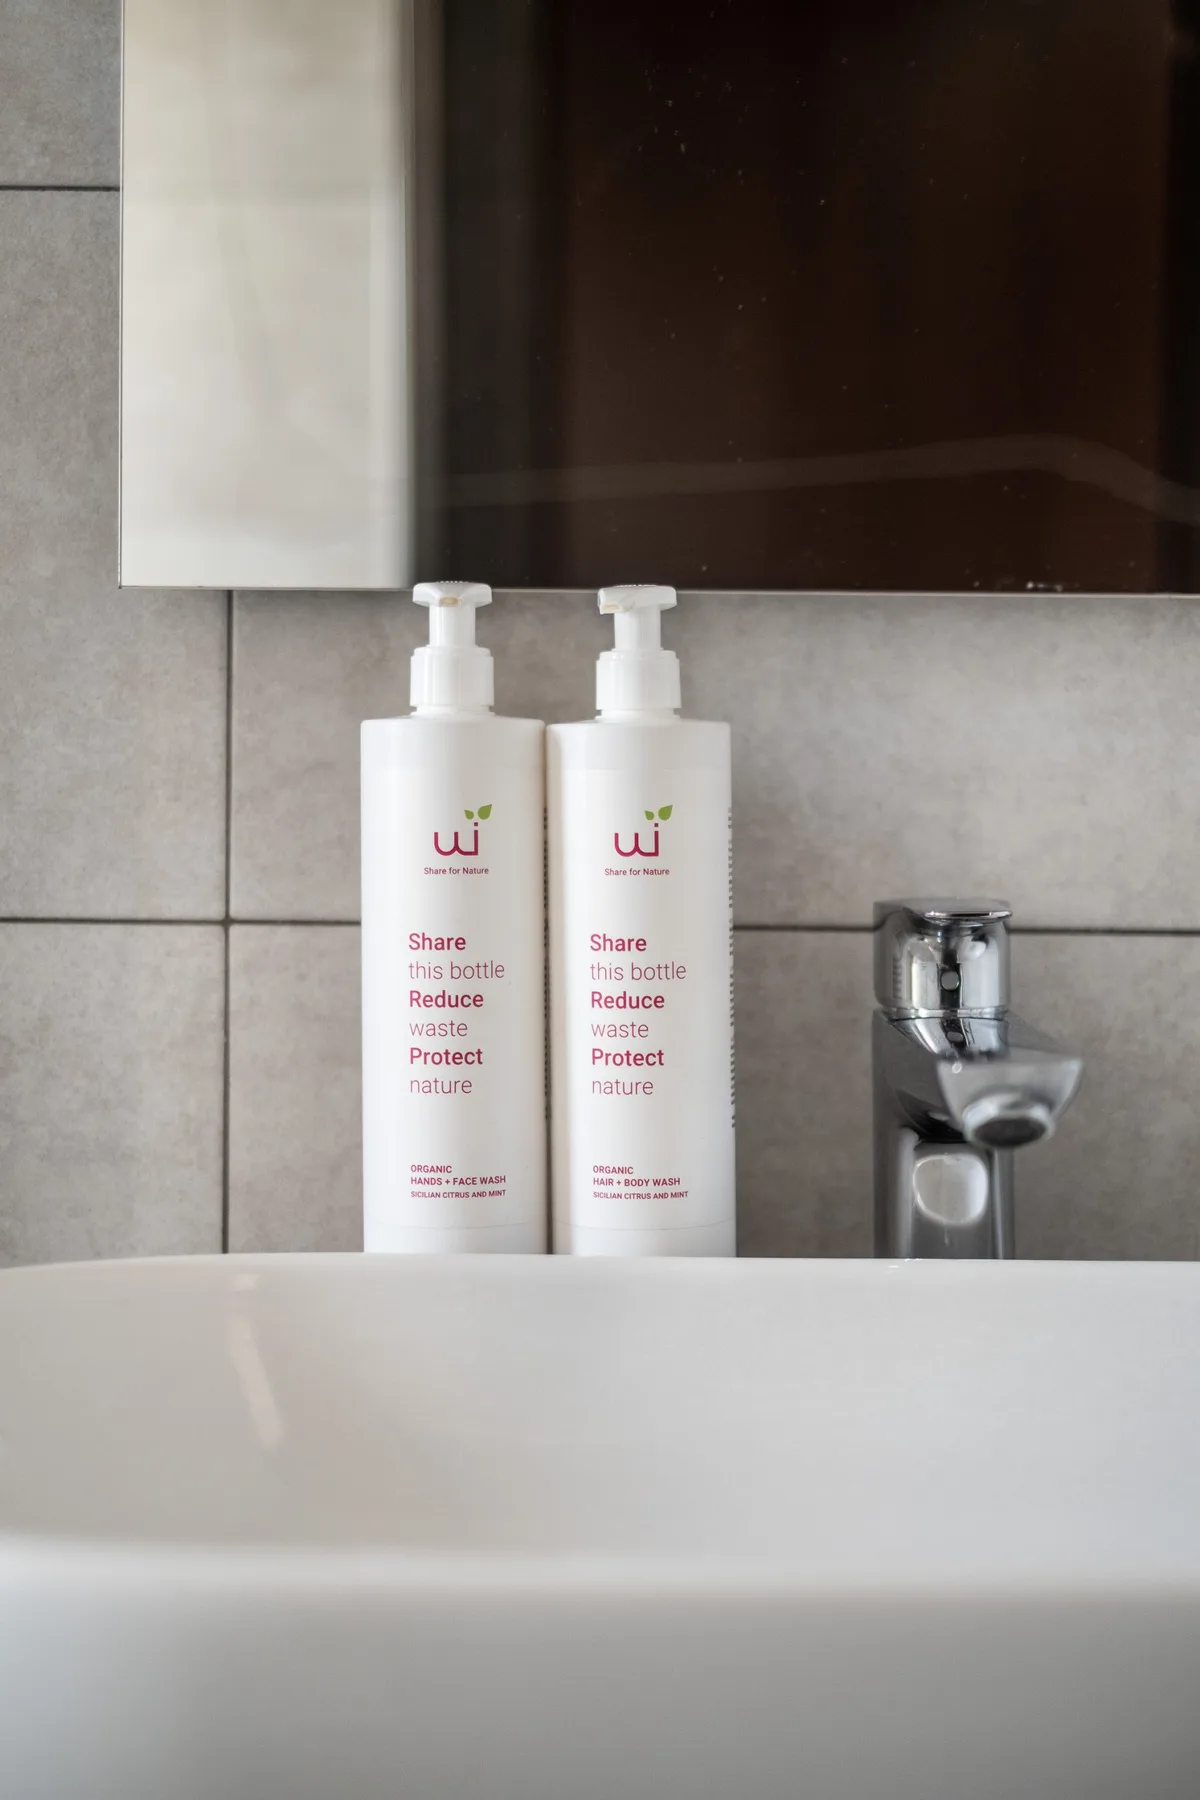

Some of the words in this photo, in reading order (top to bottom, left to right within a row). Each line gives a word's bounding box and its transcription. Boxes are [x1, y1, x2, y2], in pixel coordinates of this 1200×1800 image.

[423, 867, 447, 875] Share
[449, 866, 461, 875] for
[463, 866, 490, 875] Nature
[604, 868, 628, 876] Share
[629, 867, 642, 876] for
[643, 867, 670, 876] Nature
[408, 932, 467, 952] Share
[589, 933, 648, 953] Share
[408, 961, 443, 980] this
[450, 960, 505, 979] bottle
[590, 962, 624, 981] this
[631, 961, 687, 980] bottle
[409, 989, 484, 1009] Reduce
[590, 990, 665, 1010] Reduce
[409, 1019, 468, 1037] waste
[591, 1020, 649, 1039] waste
[409, 1047, 483, 1066] Protect
[591, 1047, 665, 1067] Protect
[409, 1077, 473, 1095] nature
[591, 1078, 654, 1096] nature
[410, 1164, 452, 1174] ORGANIC
[592, 1165, 634, 1175] ORGANIC
[410, 1176, 442, 1186] HANDS
[452, 1176, 477, 1186] FACE
[479, 1175, 506, 1185] WASH
[592, 1177, 614, 1187] HAIR
[624, 1177, 650, 1187] BODY
[652, 1177, 680, 1187] WASH
[410, 1190, 440, 1199] SICILIAN
[442, 1190, 469, 1199] CITRUS
[471, 1190, 487, 1199] AND
[488, 1189, 506, 1198] MINT
[592, 1191, 622, 1200] SICILIAN
[624, 1191, 651, 1200] CITRUS
[653, 1191, 669, 1200] AND
[670, 1191, 689, 1199] MINT
